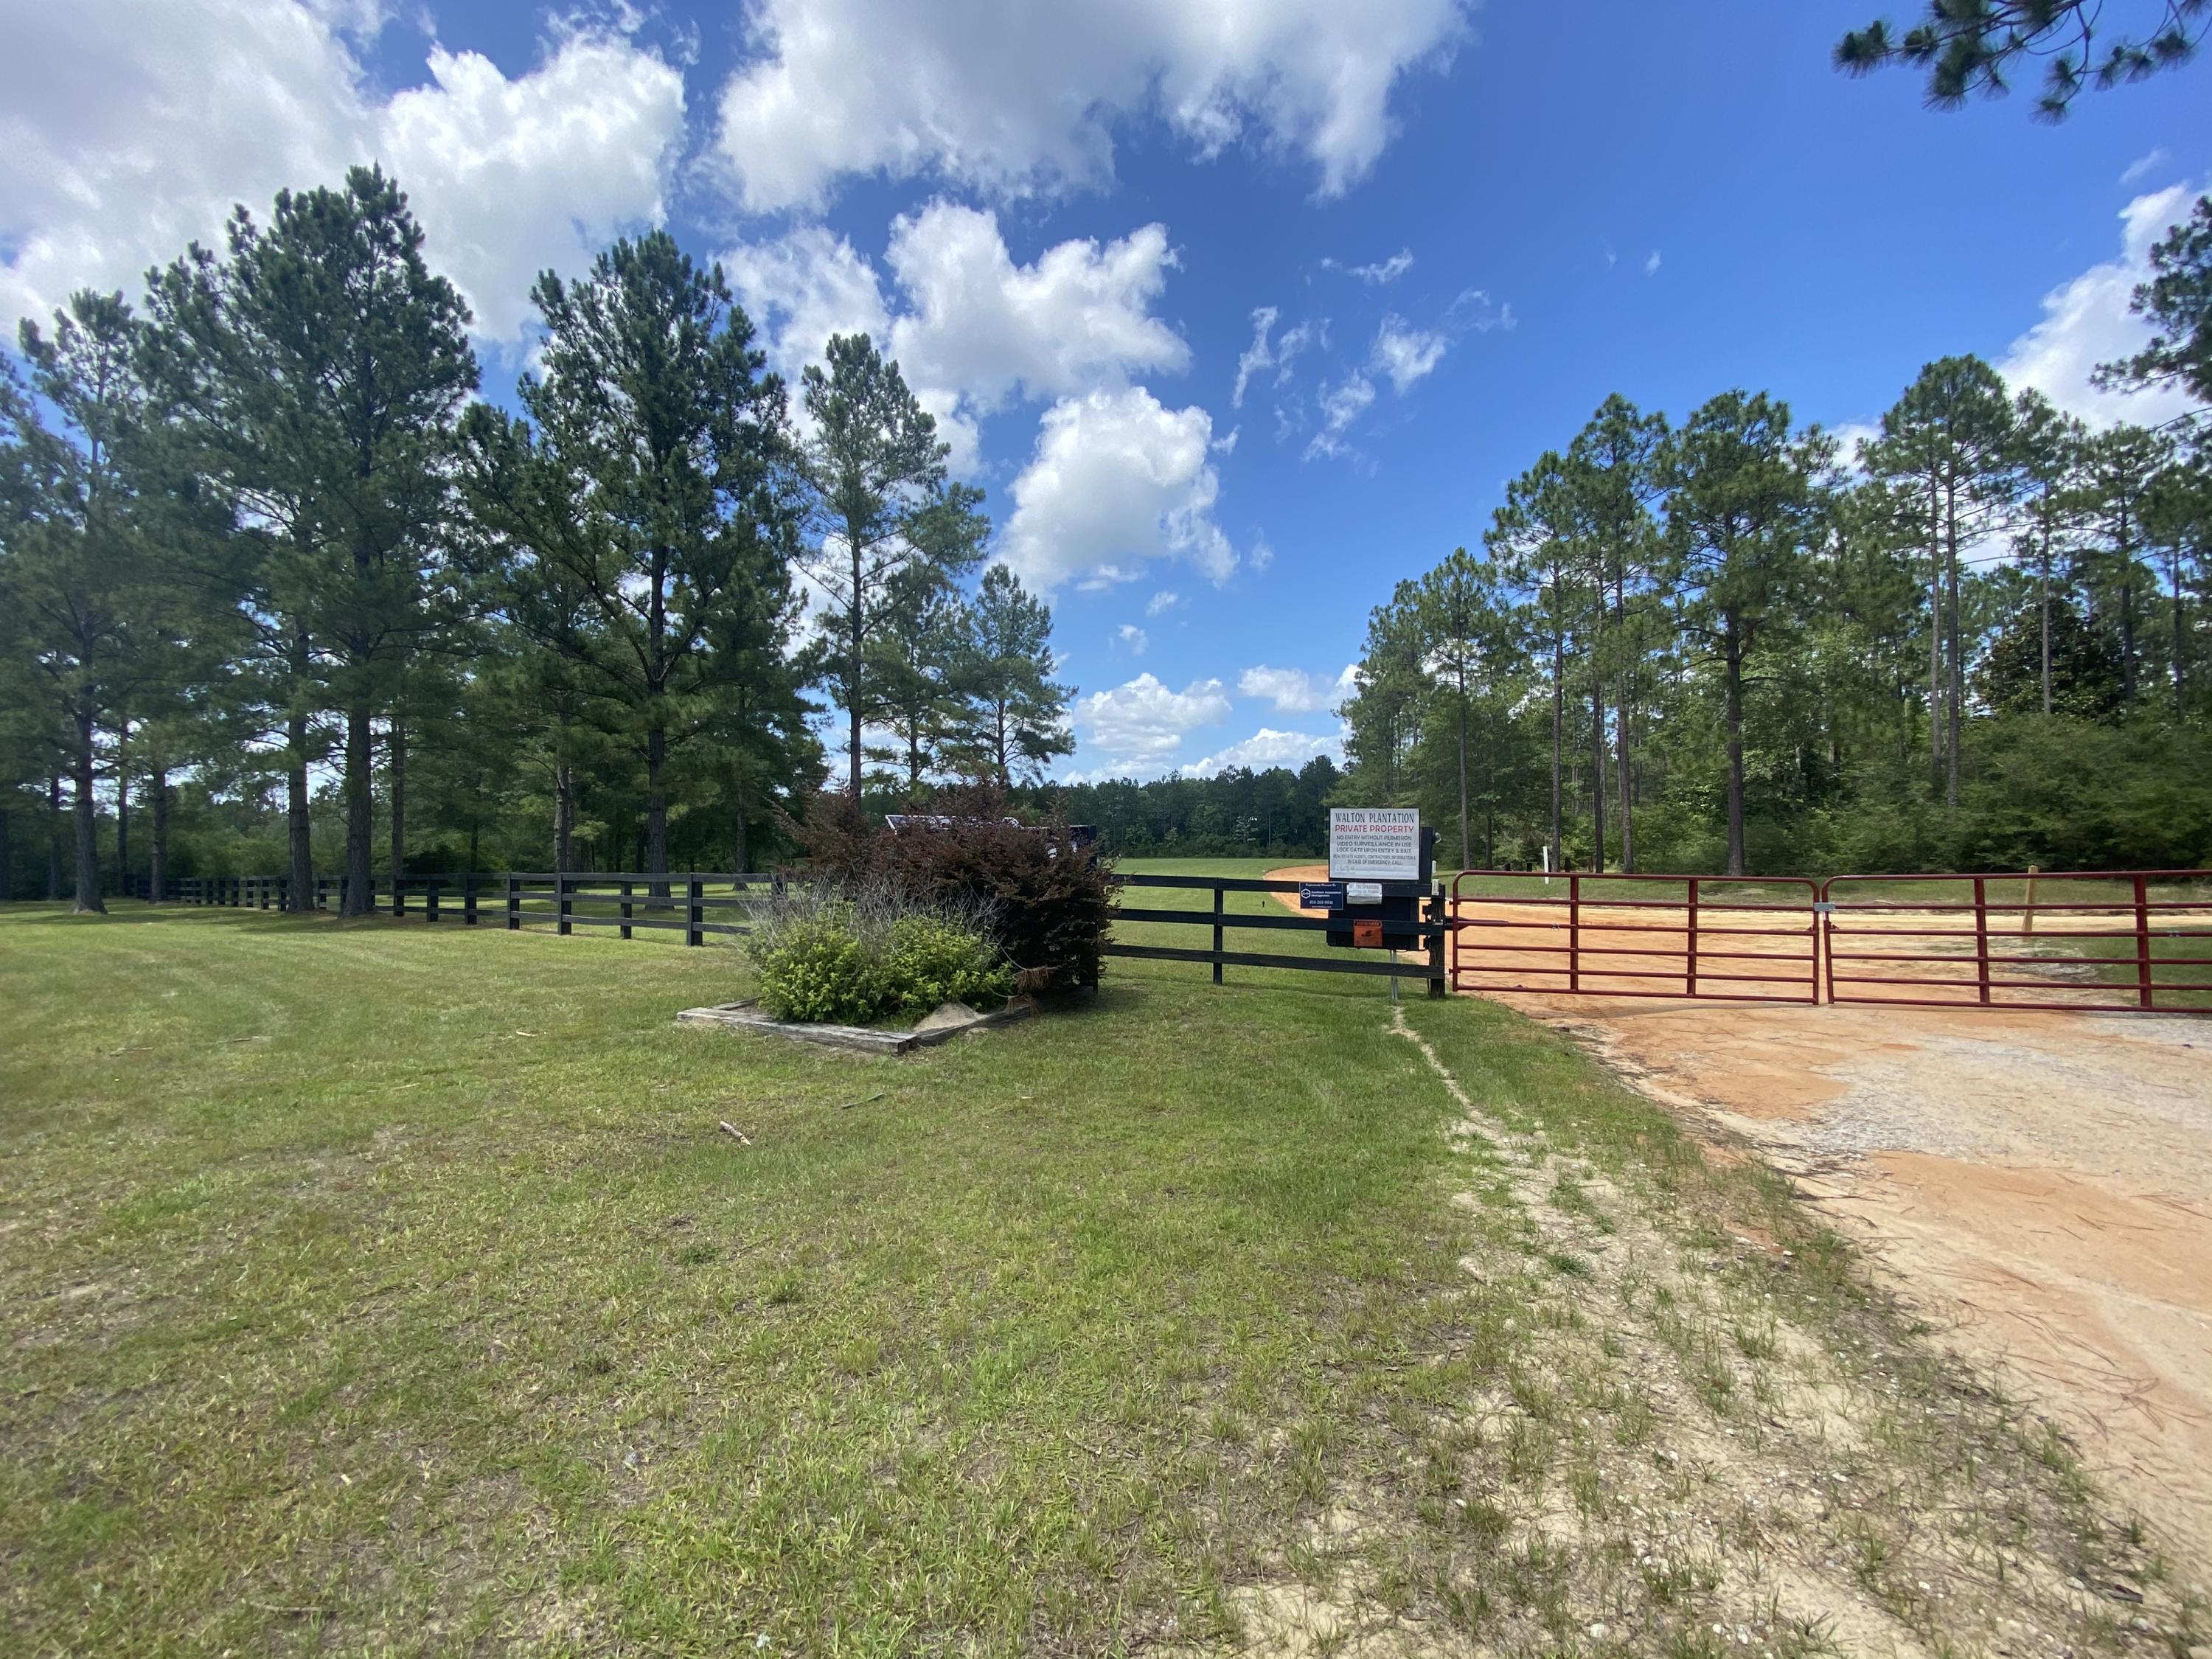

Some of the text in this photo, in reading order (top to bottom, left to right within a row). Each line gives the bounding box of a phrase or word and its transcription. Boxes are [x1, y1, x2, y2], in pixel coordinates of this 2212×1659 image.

[1335, 813, 1414, 824] WALTON PLANTATION
[1335, 824, 1414, 833] PRIVATE PROPERTY
